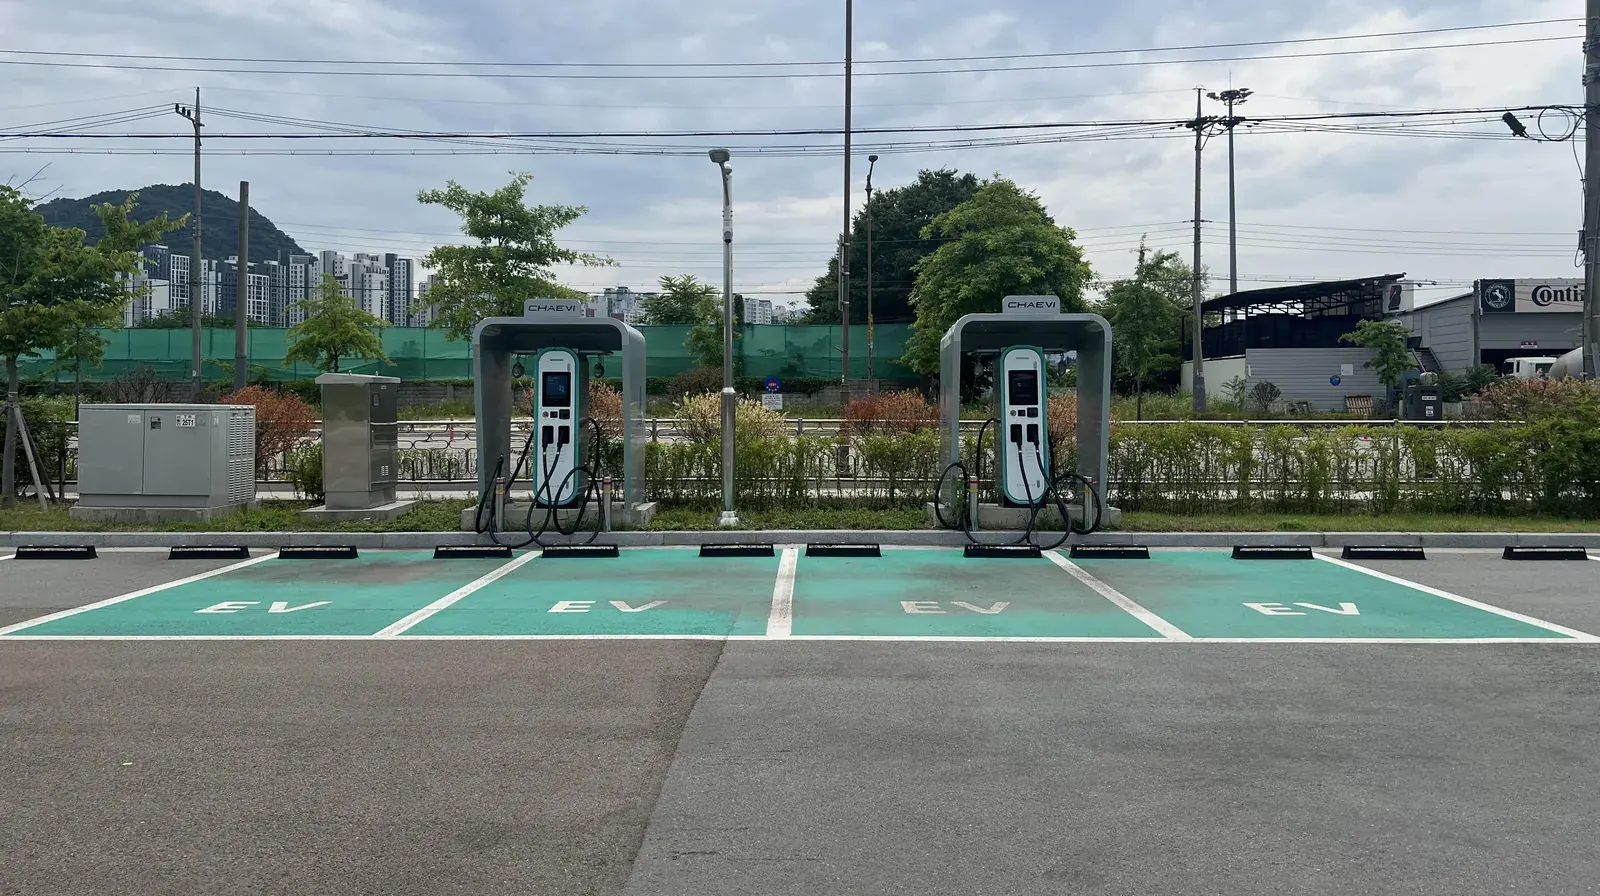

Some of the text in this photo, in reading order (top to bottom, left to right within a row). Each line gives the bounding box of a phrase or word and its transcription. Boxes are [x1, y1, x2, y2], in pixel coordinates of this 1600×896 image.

[528, 304, 576, 312] CHAEVI
[1007, 301, 1056, 309] CHAEVI
[193, 601, 333, 614] EV
[546, 600, 668, 613] EV
[900, 601, 1010, 614] EV
[1242, 602, 1360, 615] EV
